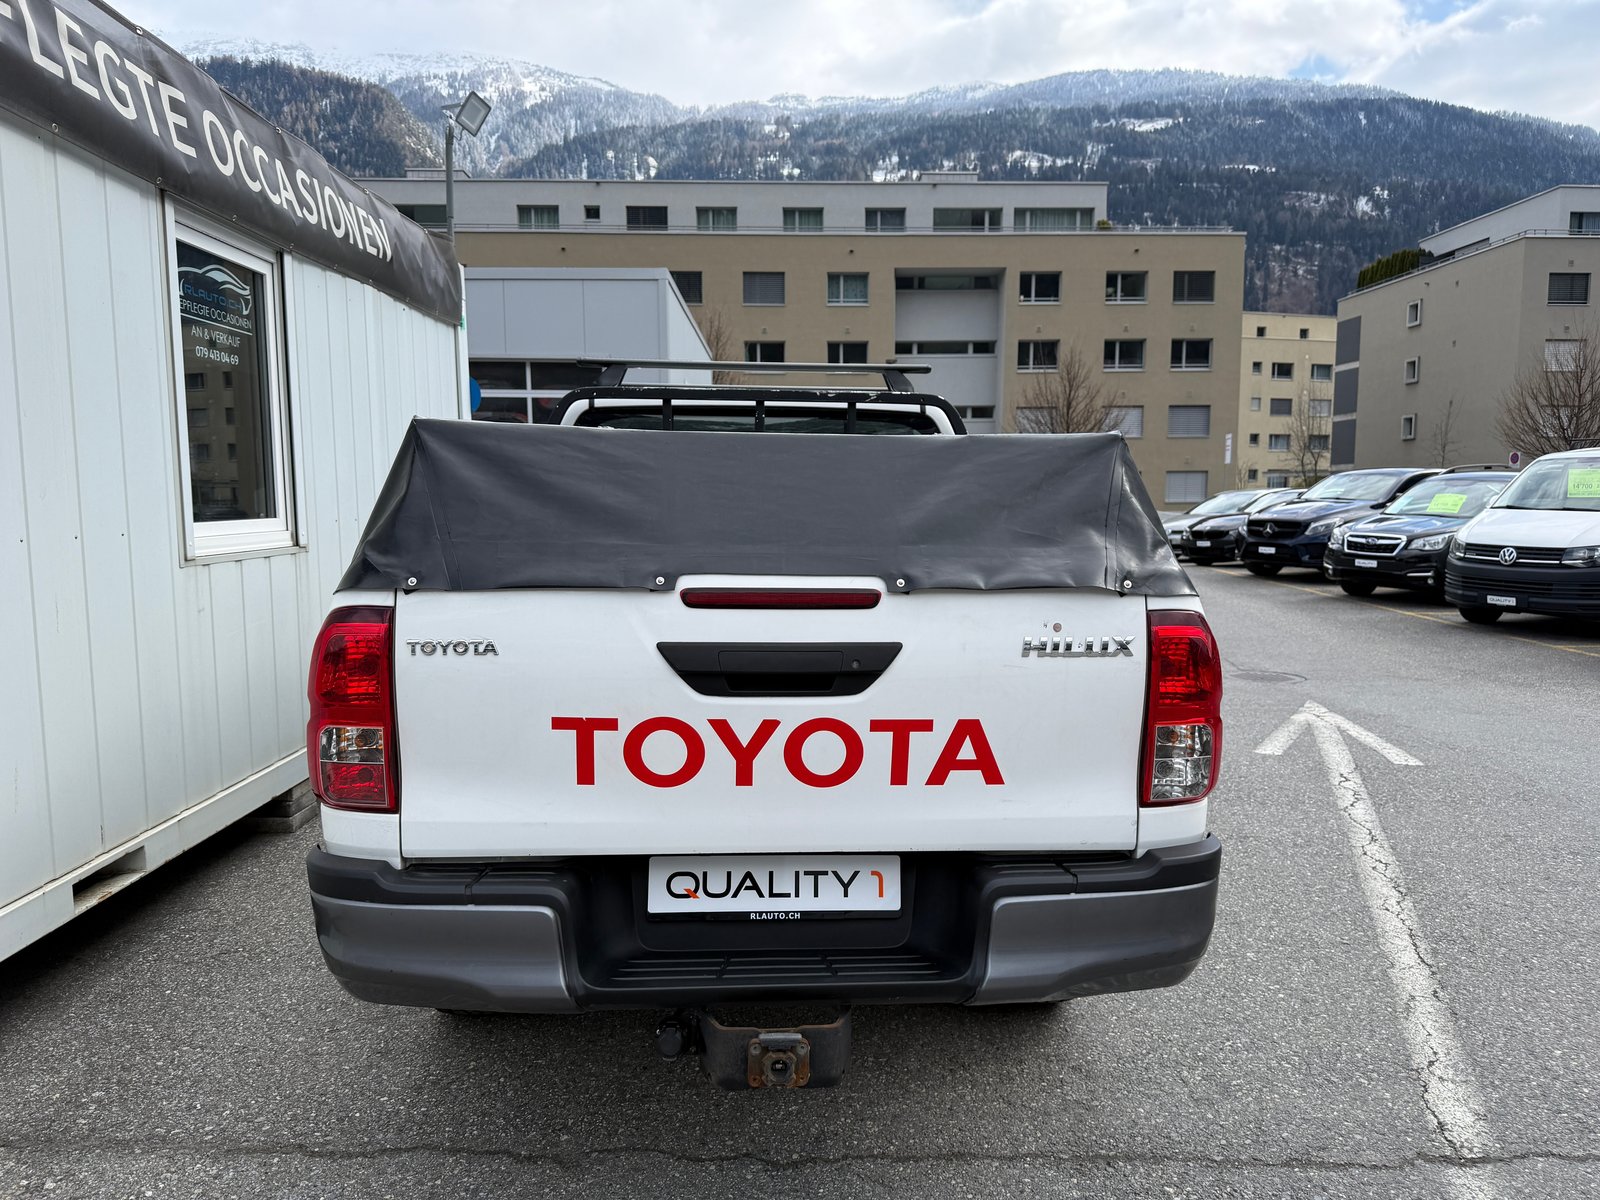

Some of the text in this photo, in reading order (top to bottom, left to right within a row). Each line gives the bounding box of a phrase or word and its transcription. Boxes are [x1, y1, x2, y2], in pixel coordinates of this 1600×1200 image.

[203, 110, 392, 262] OCCASIONEN
[210, 308, 252, 329] OCCASIONEN
[191, 325, 241, 347] AN & VERKAUF
[195, 345, 239, 365] 079 413 04 69
[406, 639, 499, 656] TOYOTA
[1021, 636, 1136, 657] HILUX
[551, 716, 1005, 788] TOYOTA
[666, 870, 860, 899] QUALITY
[750, 911, 801, 921] RLAUTO.CH
